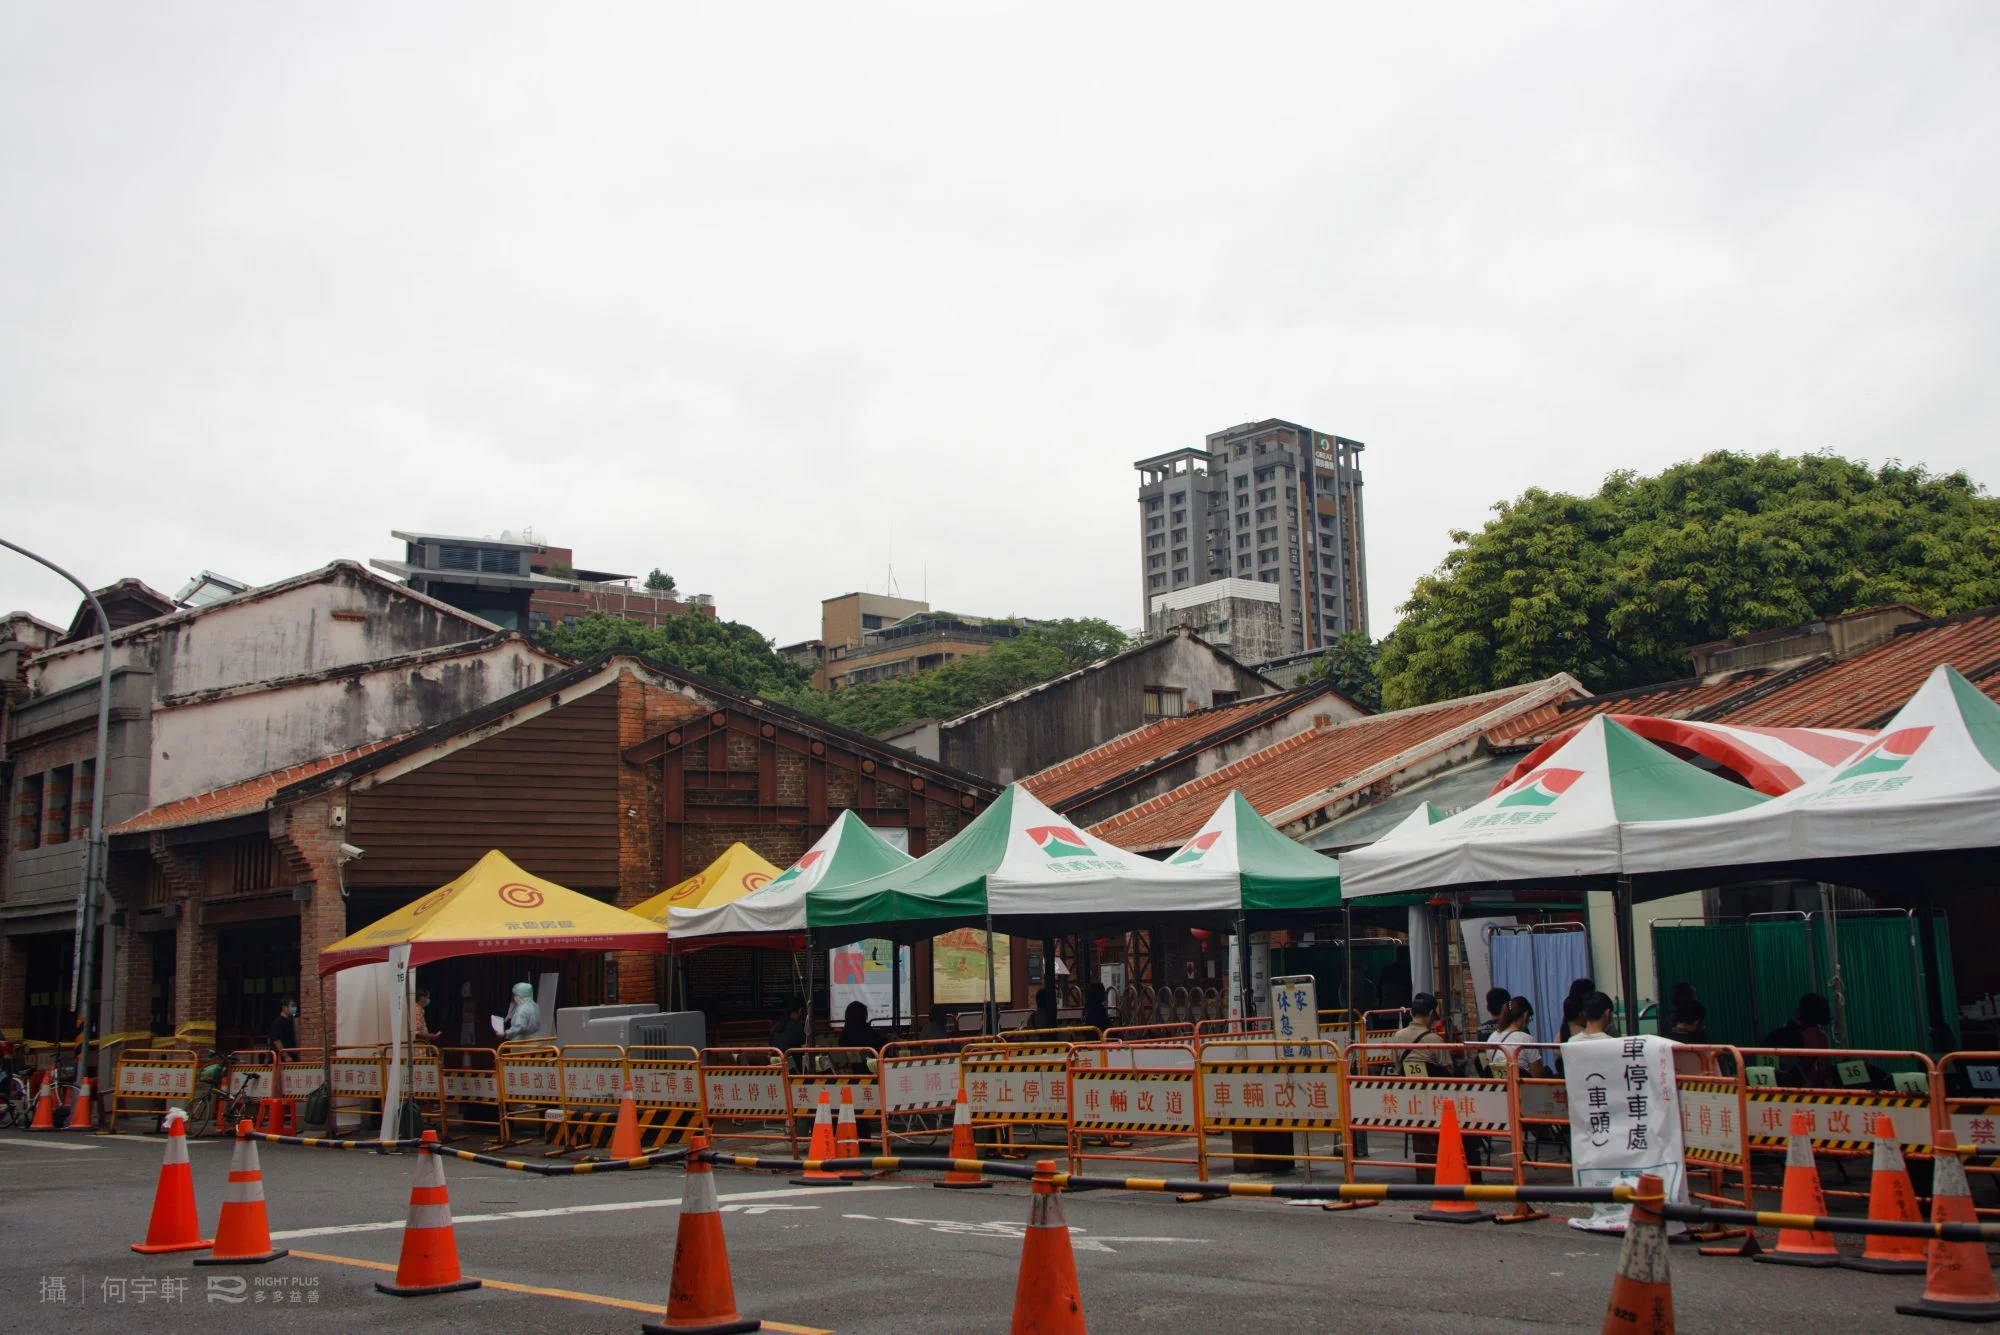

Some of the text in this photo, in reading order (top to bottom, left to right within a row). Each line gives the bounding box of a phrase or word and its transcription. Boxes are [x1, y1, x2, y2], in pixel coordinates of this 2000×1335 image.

[1409, 1064, 1422, 1075] 26
[1845, 1065, 1861, 1077] 16
[1976, 1070, 1993, 1082] 10
[125, 1071, 189, 1088] 車輛改道
[506, 1072, 557, 1091] 車輛改道
[567, 1073, 621, 1092] 禁止停車
[635, 1075, 695, 1094] 禁止停車
[1755, 1074, 1768, 1085] 17
[713, 1083, 778, 1101] 禁止停車
[798, 1087, 874, 1102] 禁車
[972, 1079, 1066, 1103] 禁止停車
[1213, 1080, 1329, 1108] 車輛改道
[1621, 1037, 1648, 1150] 車停車處
[1085, 1088, 1183, 1114] 車輛改道
[1969, 1118, 1996, 1144] 禁
